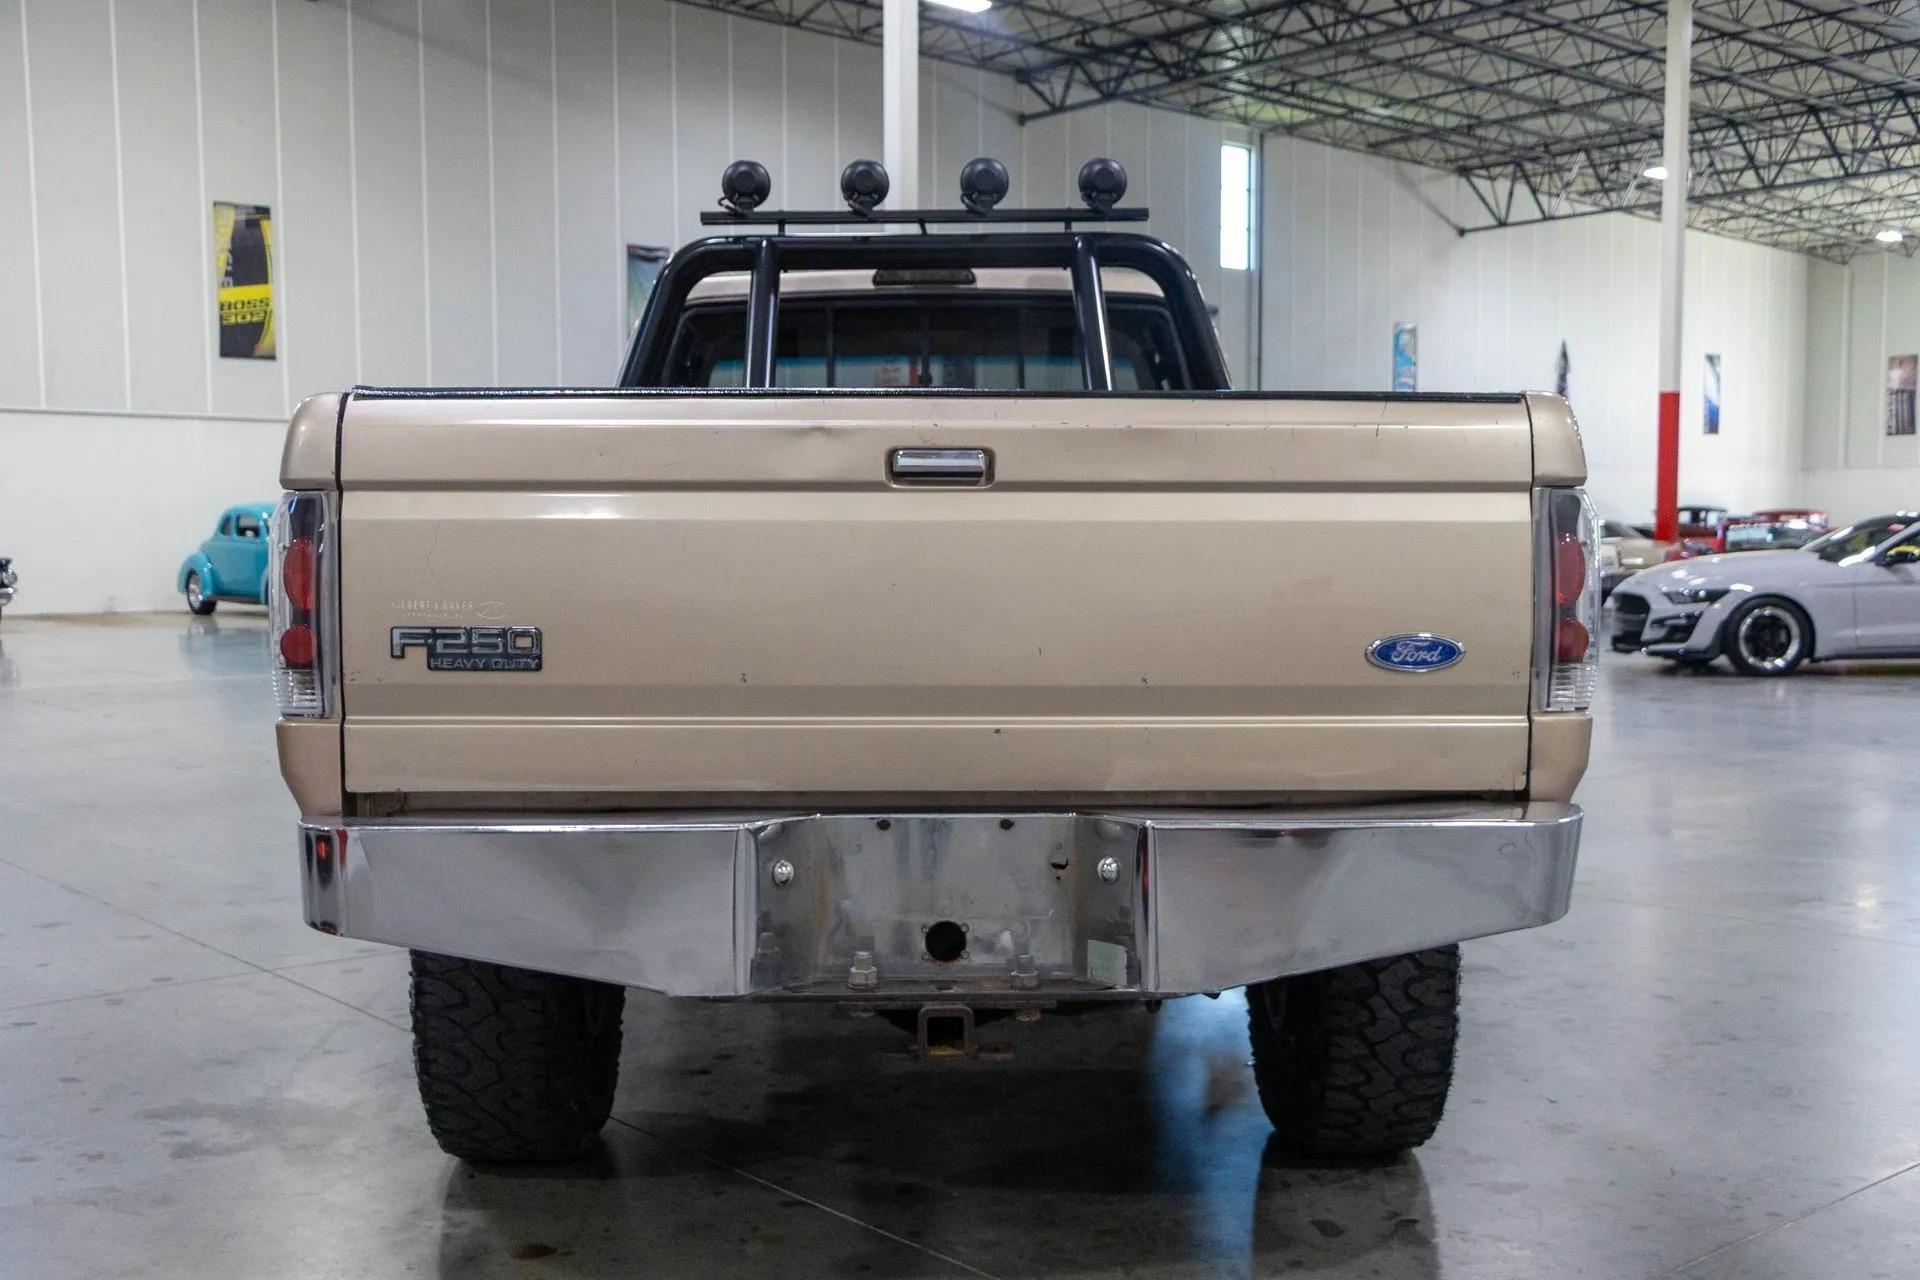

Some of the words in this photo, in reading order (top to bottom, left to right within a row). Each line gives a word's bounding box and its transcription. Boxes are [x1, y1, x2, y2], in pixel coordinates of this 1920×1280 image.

[220, 297, 270, 311] BOSS
[1391, 640, 1443, 662] Ford
[430, 658, 486, 668] HEAVY
[492, 658, 539, 668] DUTY
